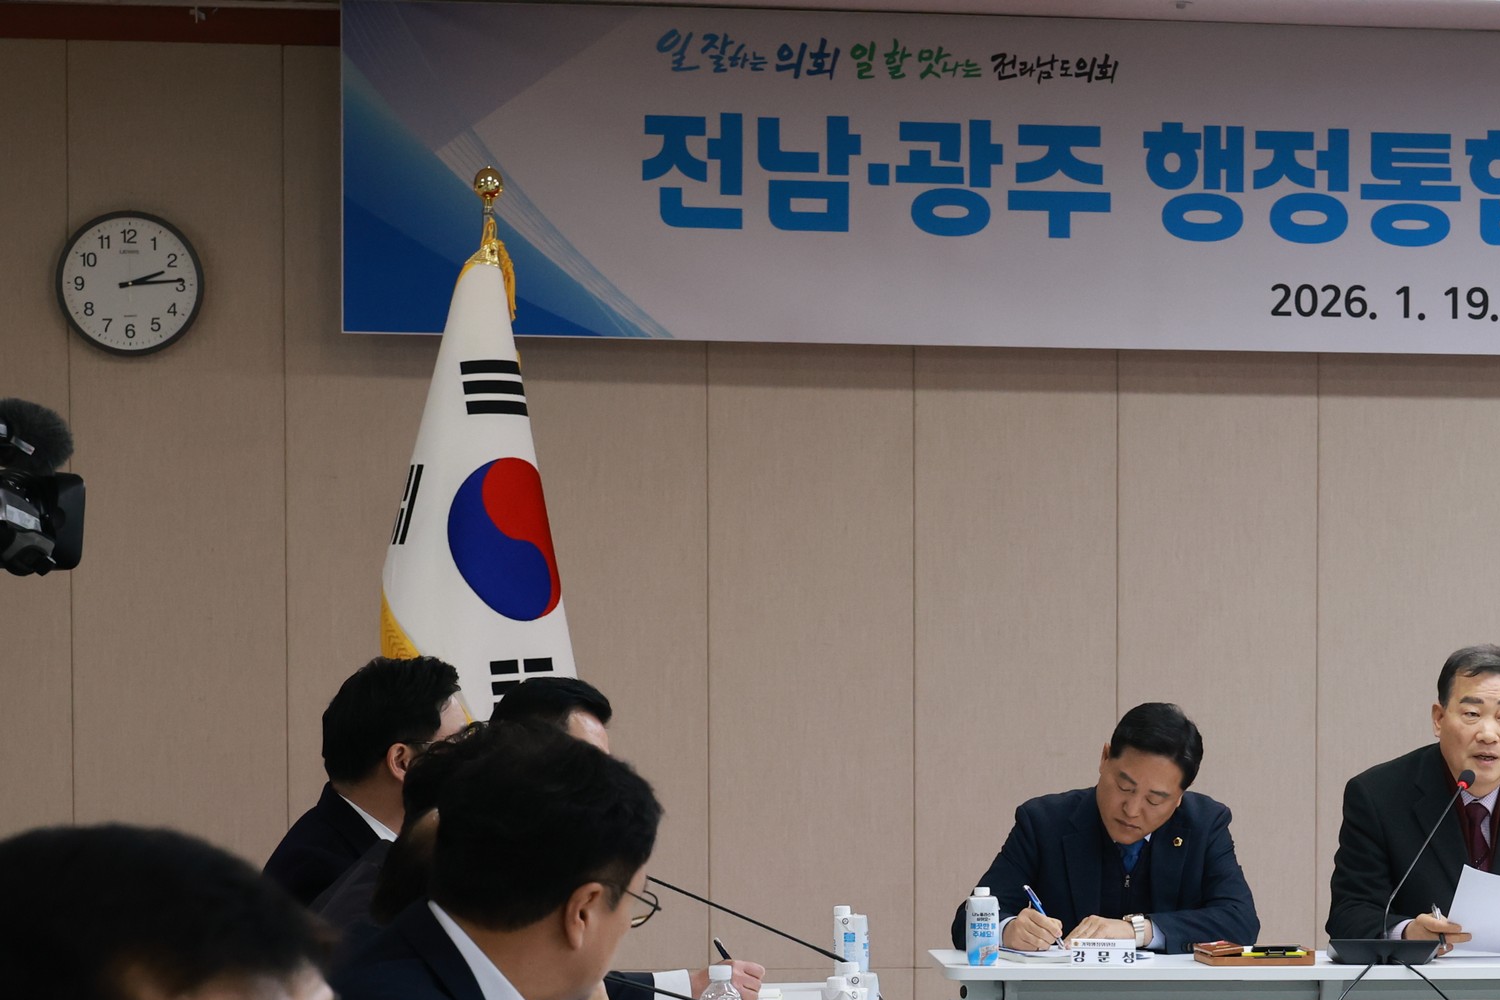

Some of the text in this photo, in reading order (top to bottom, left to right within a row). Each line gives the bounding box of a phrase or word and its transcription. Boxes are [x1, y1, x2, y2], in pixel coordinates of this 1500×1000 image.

[701, 33, 768, 73] 잘하는
[775, 37, 841, 80] 의회
[990, 52, 1119, 84] 전라남도의회
[98, 234, 110, 249] 11
[120, 229, 137, 244] 12
[151, 237, 157, 251] 1
[80, 252, 97, 267] 10
[167, 253, 178, 268] 2
[74, 276, 85, 291] 9
[83, 302, 95, 317] 8
[1270, 282, 1378, 321] 2026.
[1395, 285, 1426, 322] 1.
[167, 303, 178, 317] 4
[102, 318, 113, 332] 7
[125, 324, 136, 339] 6
[150, 318, 161, 332] 5
